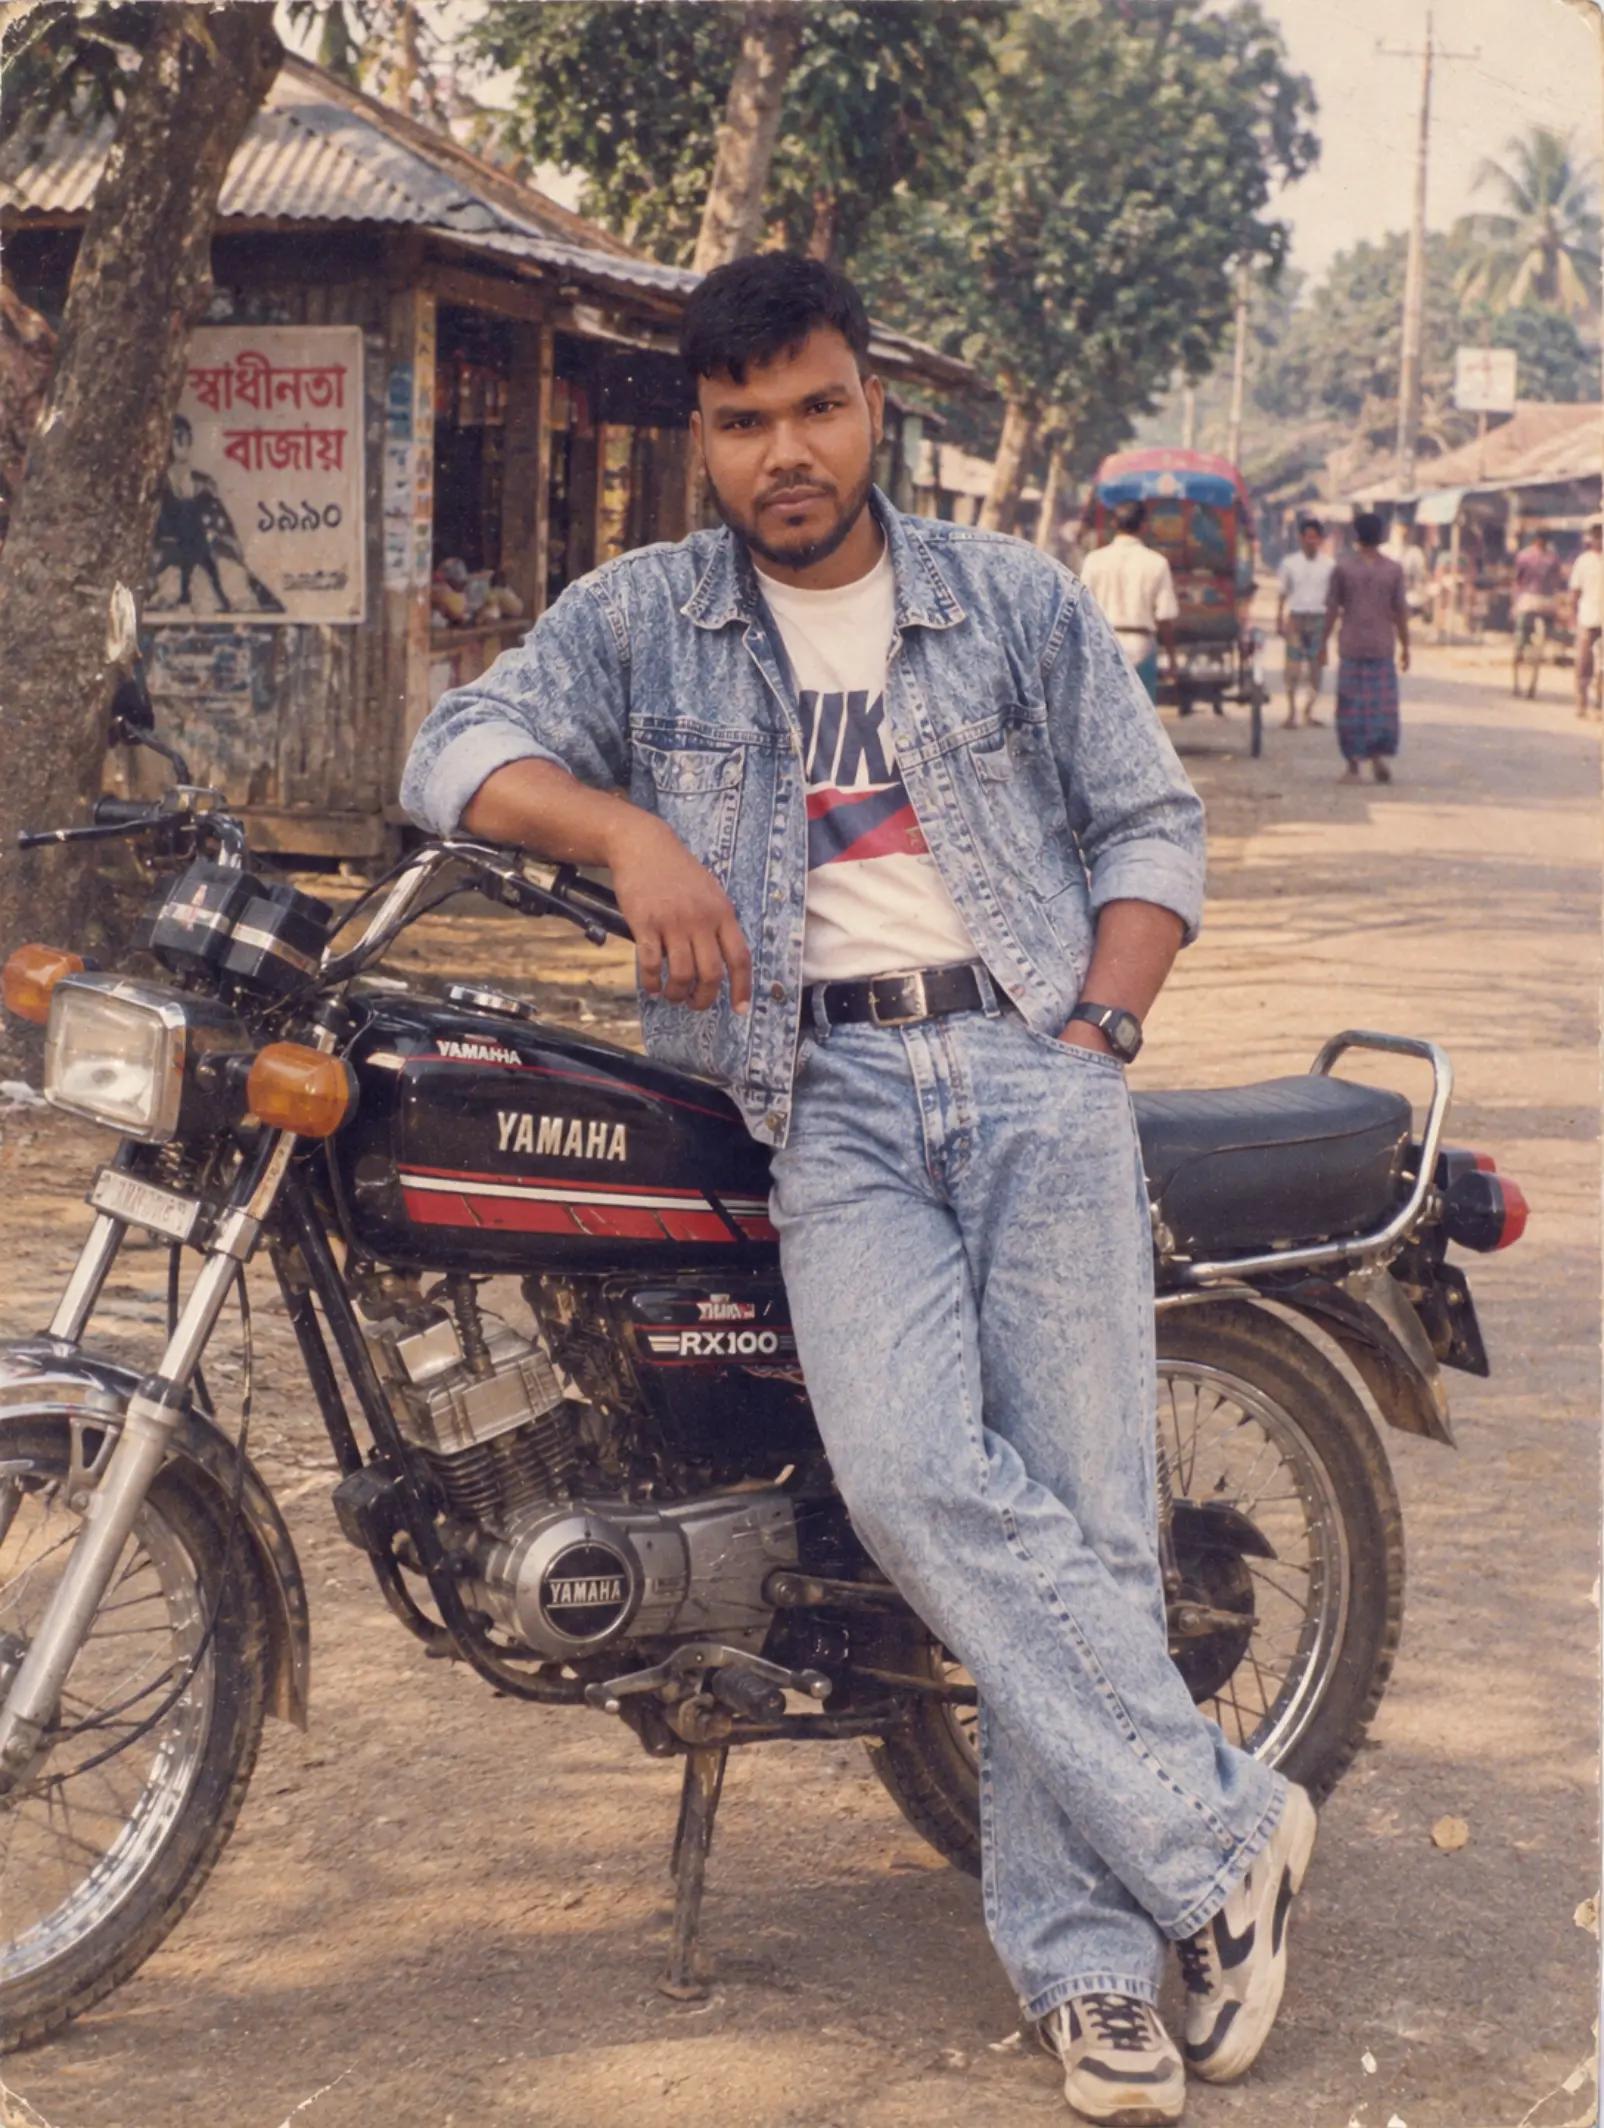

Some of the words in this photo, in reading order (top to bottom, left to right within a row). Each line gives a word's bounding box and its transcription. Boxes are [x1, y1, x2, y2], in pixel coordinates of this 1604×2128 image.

[186, 351, 348, 413] স্বাধীনতা
[223, 422, 348, 472] বাজায়
[257, 501, 342, 533] ১৯৯০
[497, 1111, 628, 1161] YAMAHA
[679, 1331, 778, 1357] RX100
[551, 1580, 621, 1604] YAMAHA
